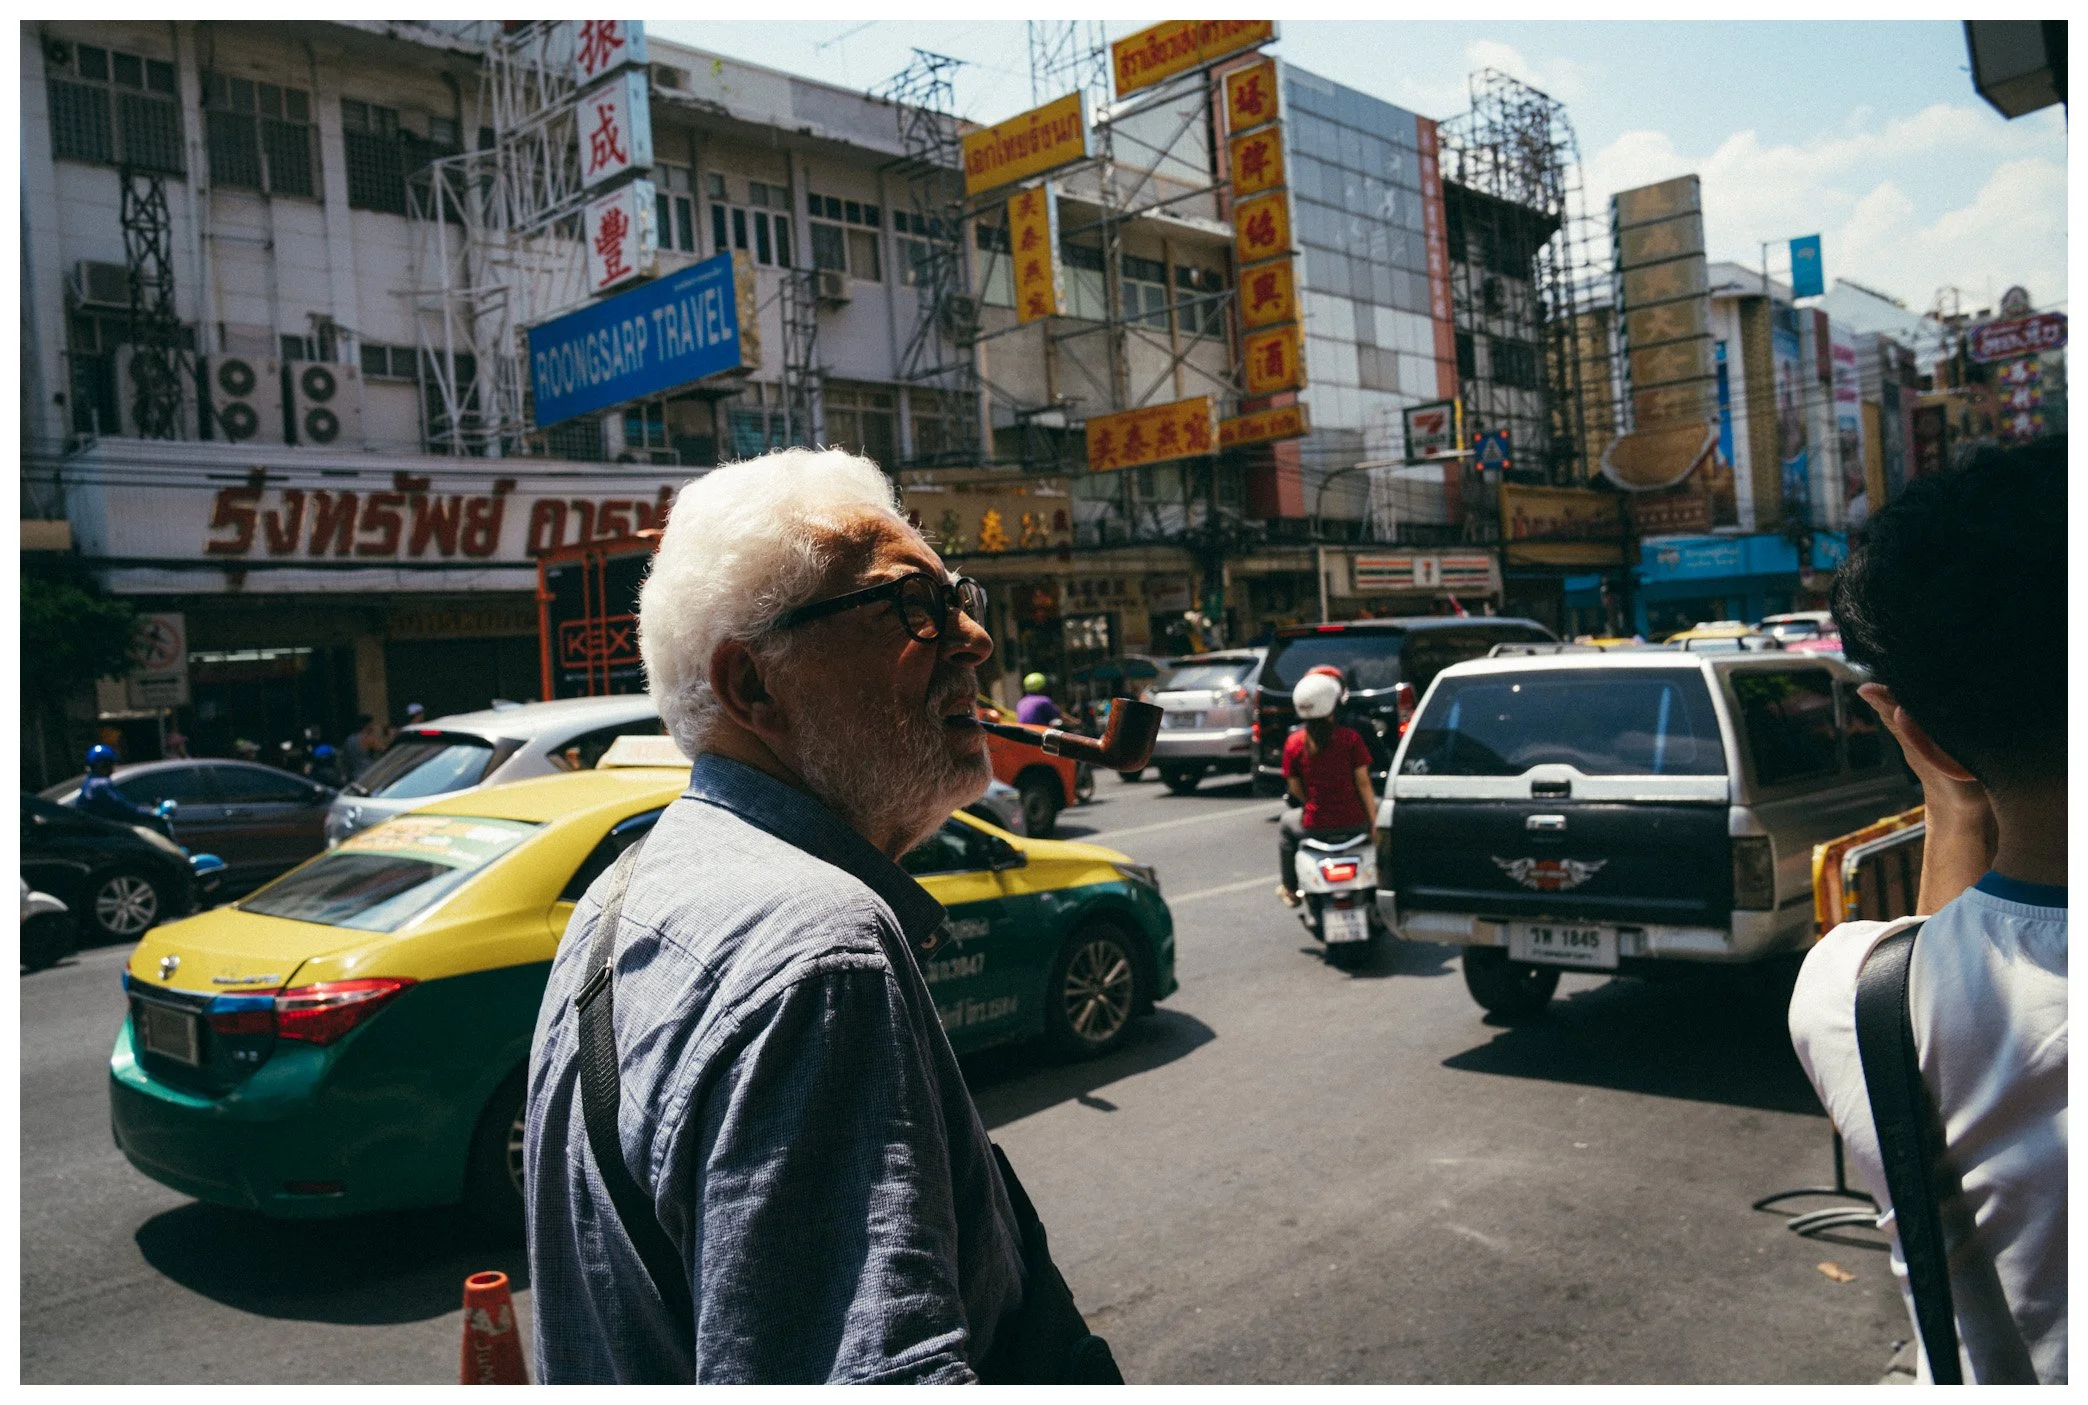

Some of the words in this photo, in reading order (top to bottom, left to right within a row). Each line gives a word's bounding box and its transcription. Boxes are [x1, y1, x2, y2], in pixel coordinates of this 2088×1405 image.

[536, 315, 648, 401] ROONGSARP
[652, 286, 732, 361] TRAVEL
[567, 627, 631, 656] KEX
[1562, 929, 1599, 948] 1845
